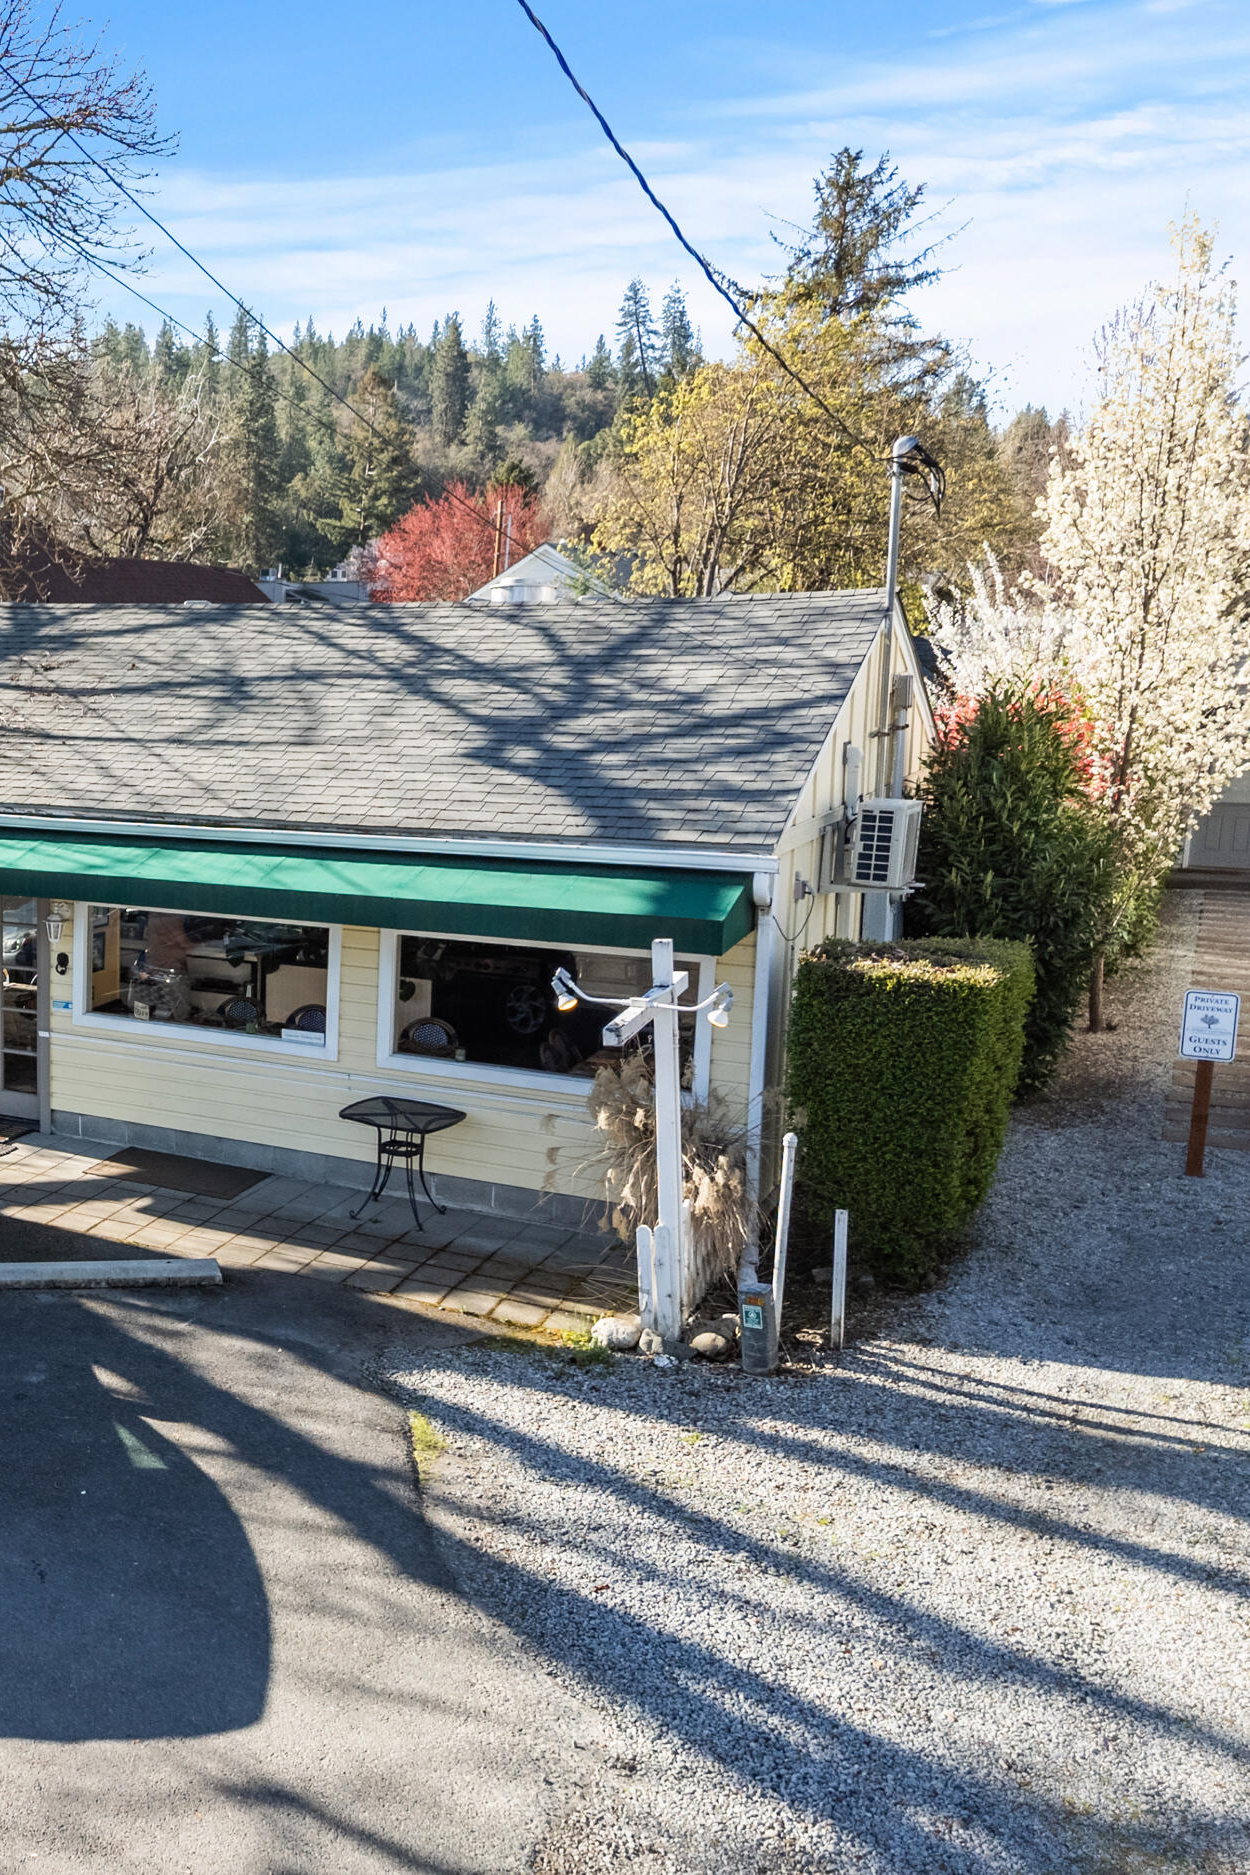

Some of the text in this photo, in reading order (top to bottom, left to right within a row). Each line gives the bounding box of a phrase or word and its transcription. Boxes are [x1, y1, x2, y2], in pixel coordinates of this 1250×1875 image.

[1194, 996, 1230, 1005] PRIVATE
[1189, 1003, 1233, 1013] DRIVEWAY
[1188, 1035, 1228, 1046] GUESTS
[1193, 1046, 1221, 1055] ONLY
